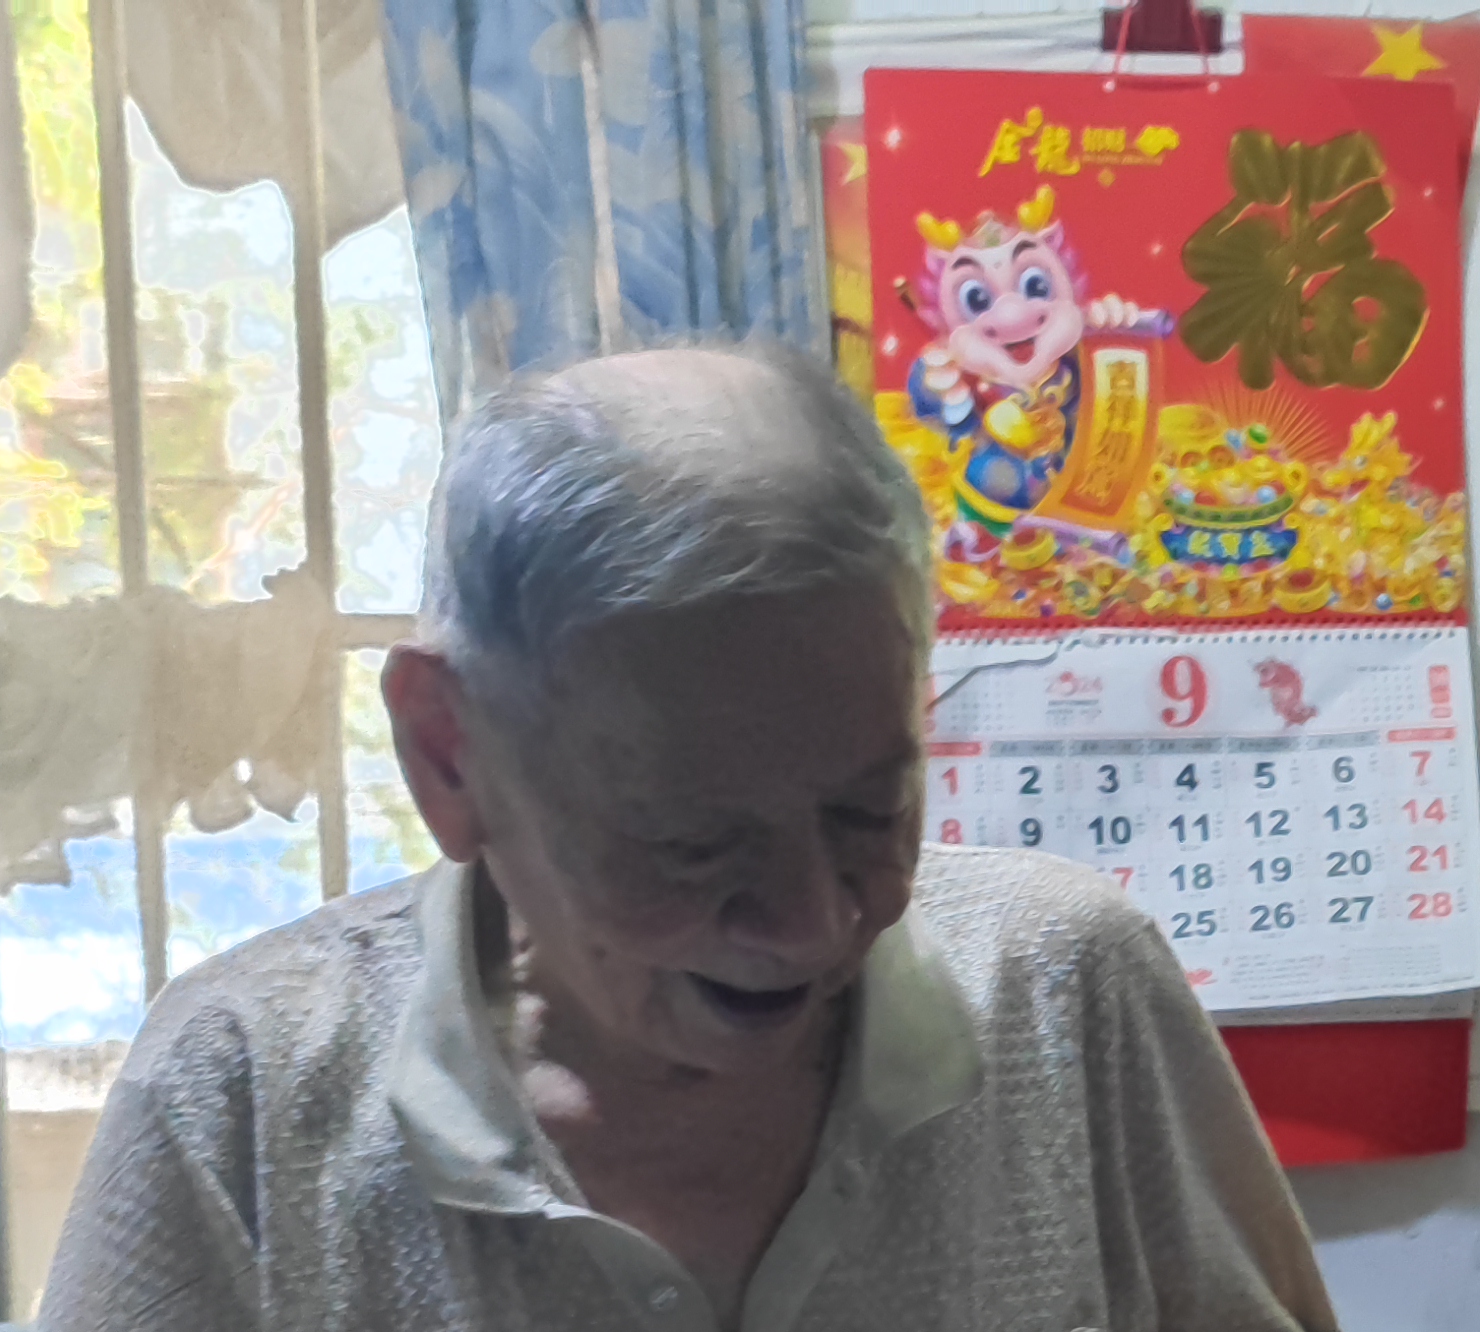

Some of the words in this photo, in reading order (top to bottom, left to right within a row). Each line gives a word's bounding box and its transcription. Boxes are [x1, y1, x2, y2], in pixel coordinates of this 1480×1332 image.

[1160, 655, 1207, 728] 9
[941, 766, 958, 795] 1
[1019, 766, 1042, 794] 2
[1098, 764, 1119, 793] 3
[1176, 763, 1199, 791] 4
[1254, 761, 1276, 789] 5
[1332, 756, 1356, 783] 6
[1410, 750, 1432, 777] 7
[941, 818, 962, 844] 8
[1020, 817, 1043, 847] 9
[1088, 815, 1132, 845] 10
[1169, 813, 1209, 843] 11
[1245, 809, 1291, 838] 12
[1323, 804, 1368, 831] 13
[1402, 798, 1446, 824] 14
[1170, 863, 1214, 892] 18
[1248, 857, 1292, 884] 19
[1326, 850, 1372, 878] 20
[1407, 845, 1448, 872] 21
[1172, 910, 1217, 939] 25
[1250, 902, 1295, 932] 26
[1328, 896, 1374, 923] 27
[1407, 892, 1452, 920] 28
